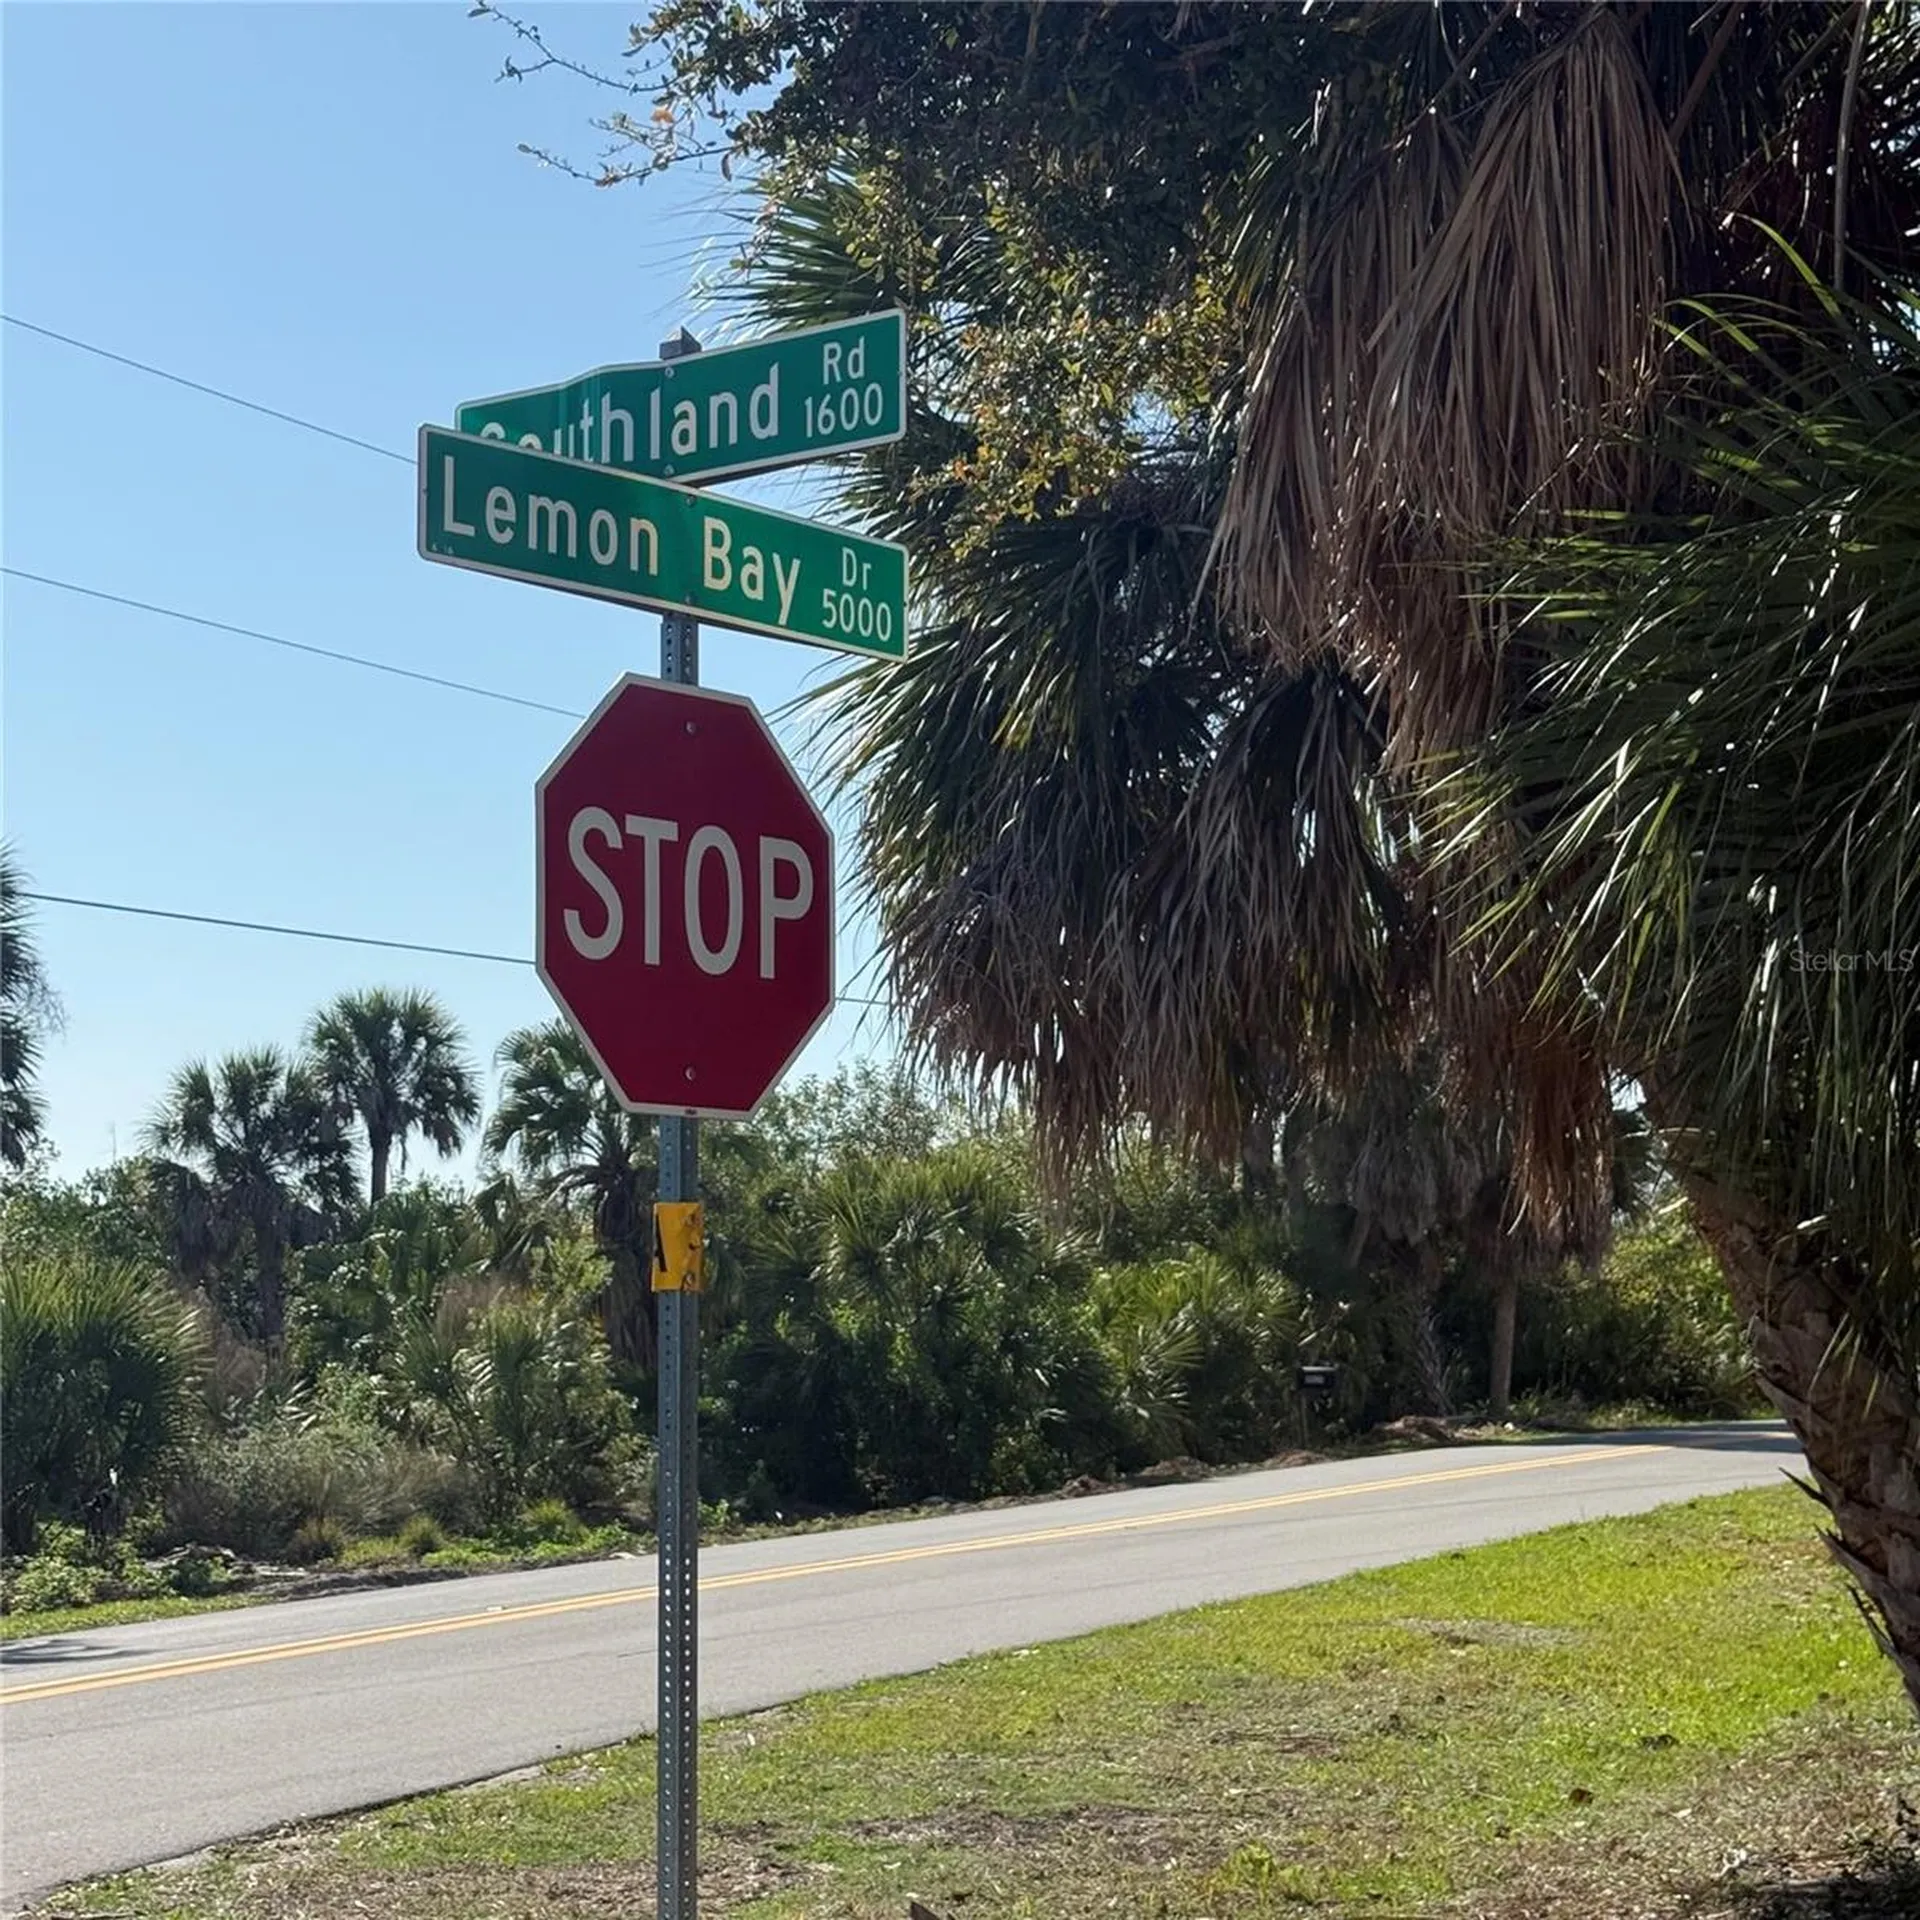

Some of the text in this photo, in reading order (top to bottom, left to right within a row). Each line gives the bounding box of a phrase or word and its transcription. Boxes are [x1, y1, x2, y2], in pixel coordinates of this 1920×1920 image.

[479, 336, 866, 464] uthland Rd
[804, 382, 884, 438] 1600
[443, 455, 873, 626] Lemon Bay Dr
[821, 590, 893, 643] 5000
[564, 806, 814, 980] STOP
